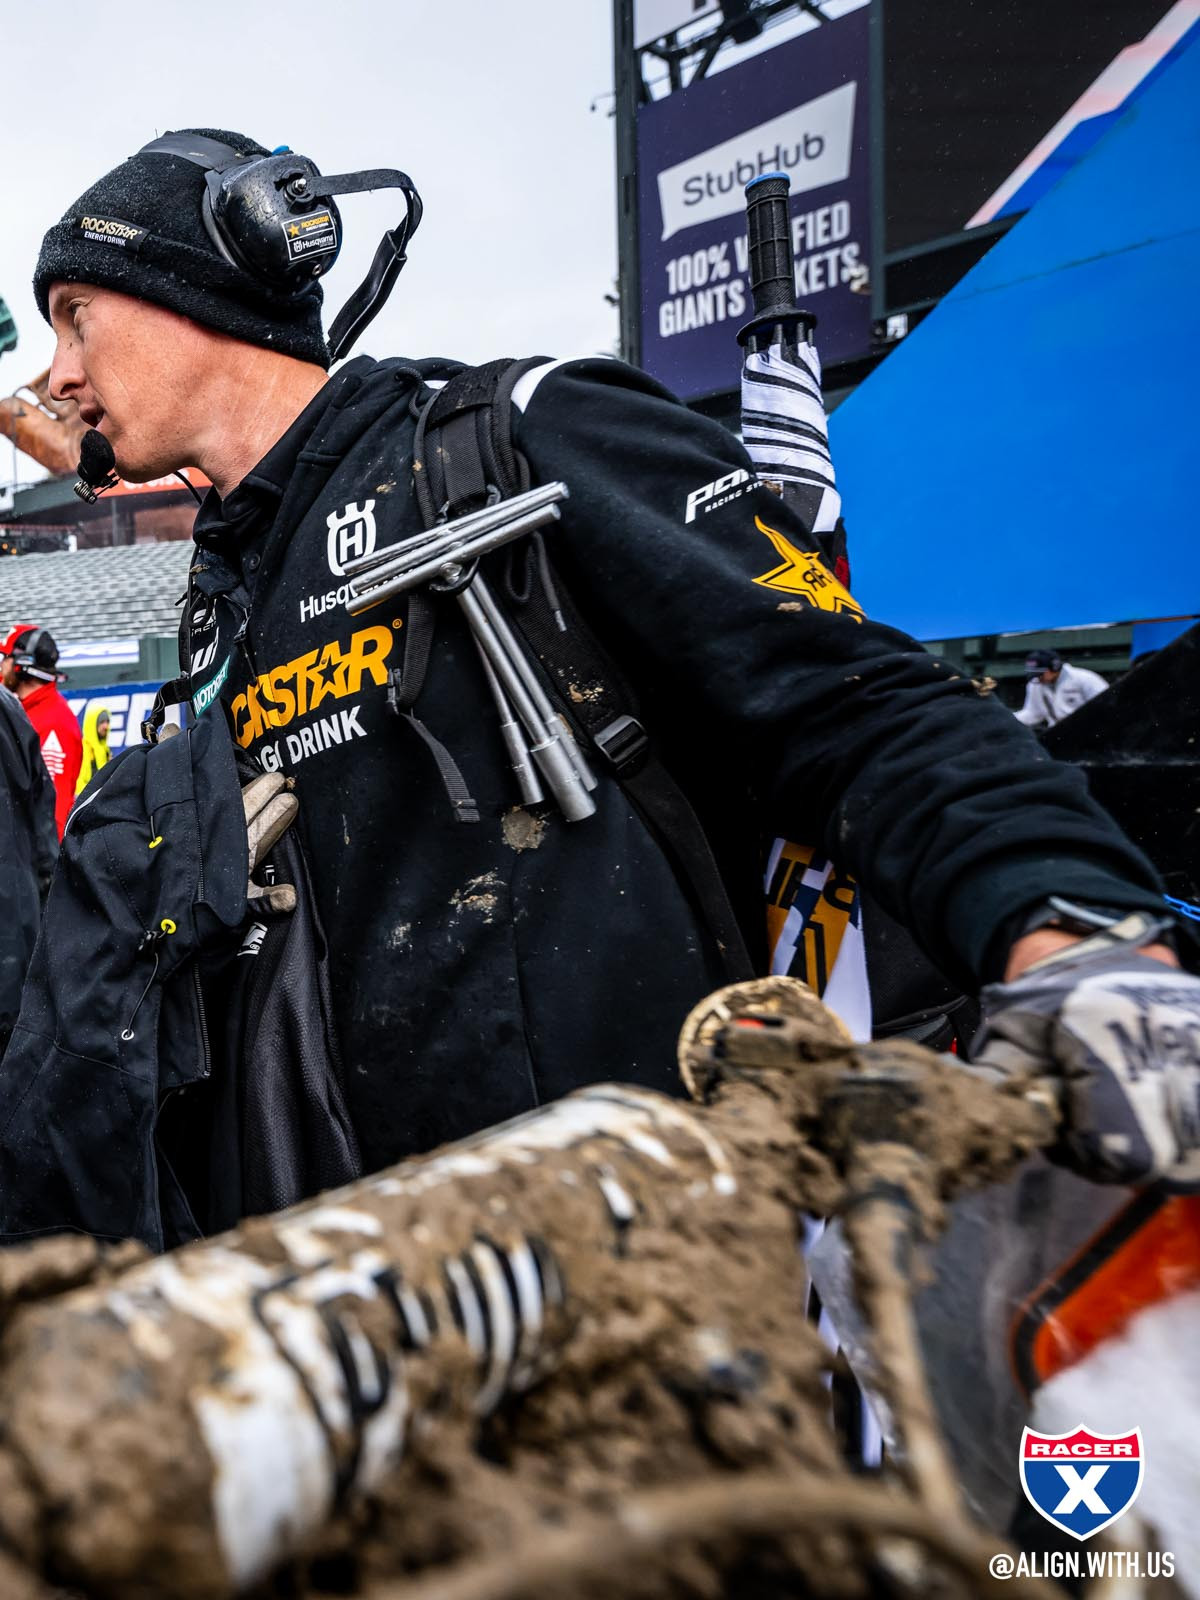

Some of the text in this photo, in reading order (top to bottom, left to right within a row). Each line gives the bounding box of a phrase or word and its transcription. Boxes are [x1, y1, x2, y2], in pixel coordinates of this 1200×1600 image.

[683, 133, 825, 206] StubHub
[81, 216, 138, 240] ROCKSTAR
[84, 231, 127, 247] ENERGY DRINK
[665, 201, 850, 295] 100% VFIED
[659, 279, 746, 338] GIANTS
[705, 489, 742, 513] RACING
[231, 625, 394, 749] CKSTAR
[285, 704, 368, 765] DRINK
